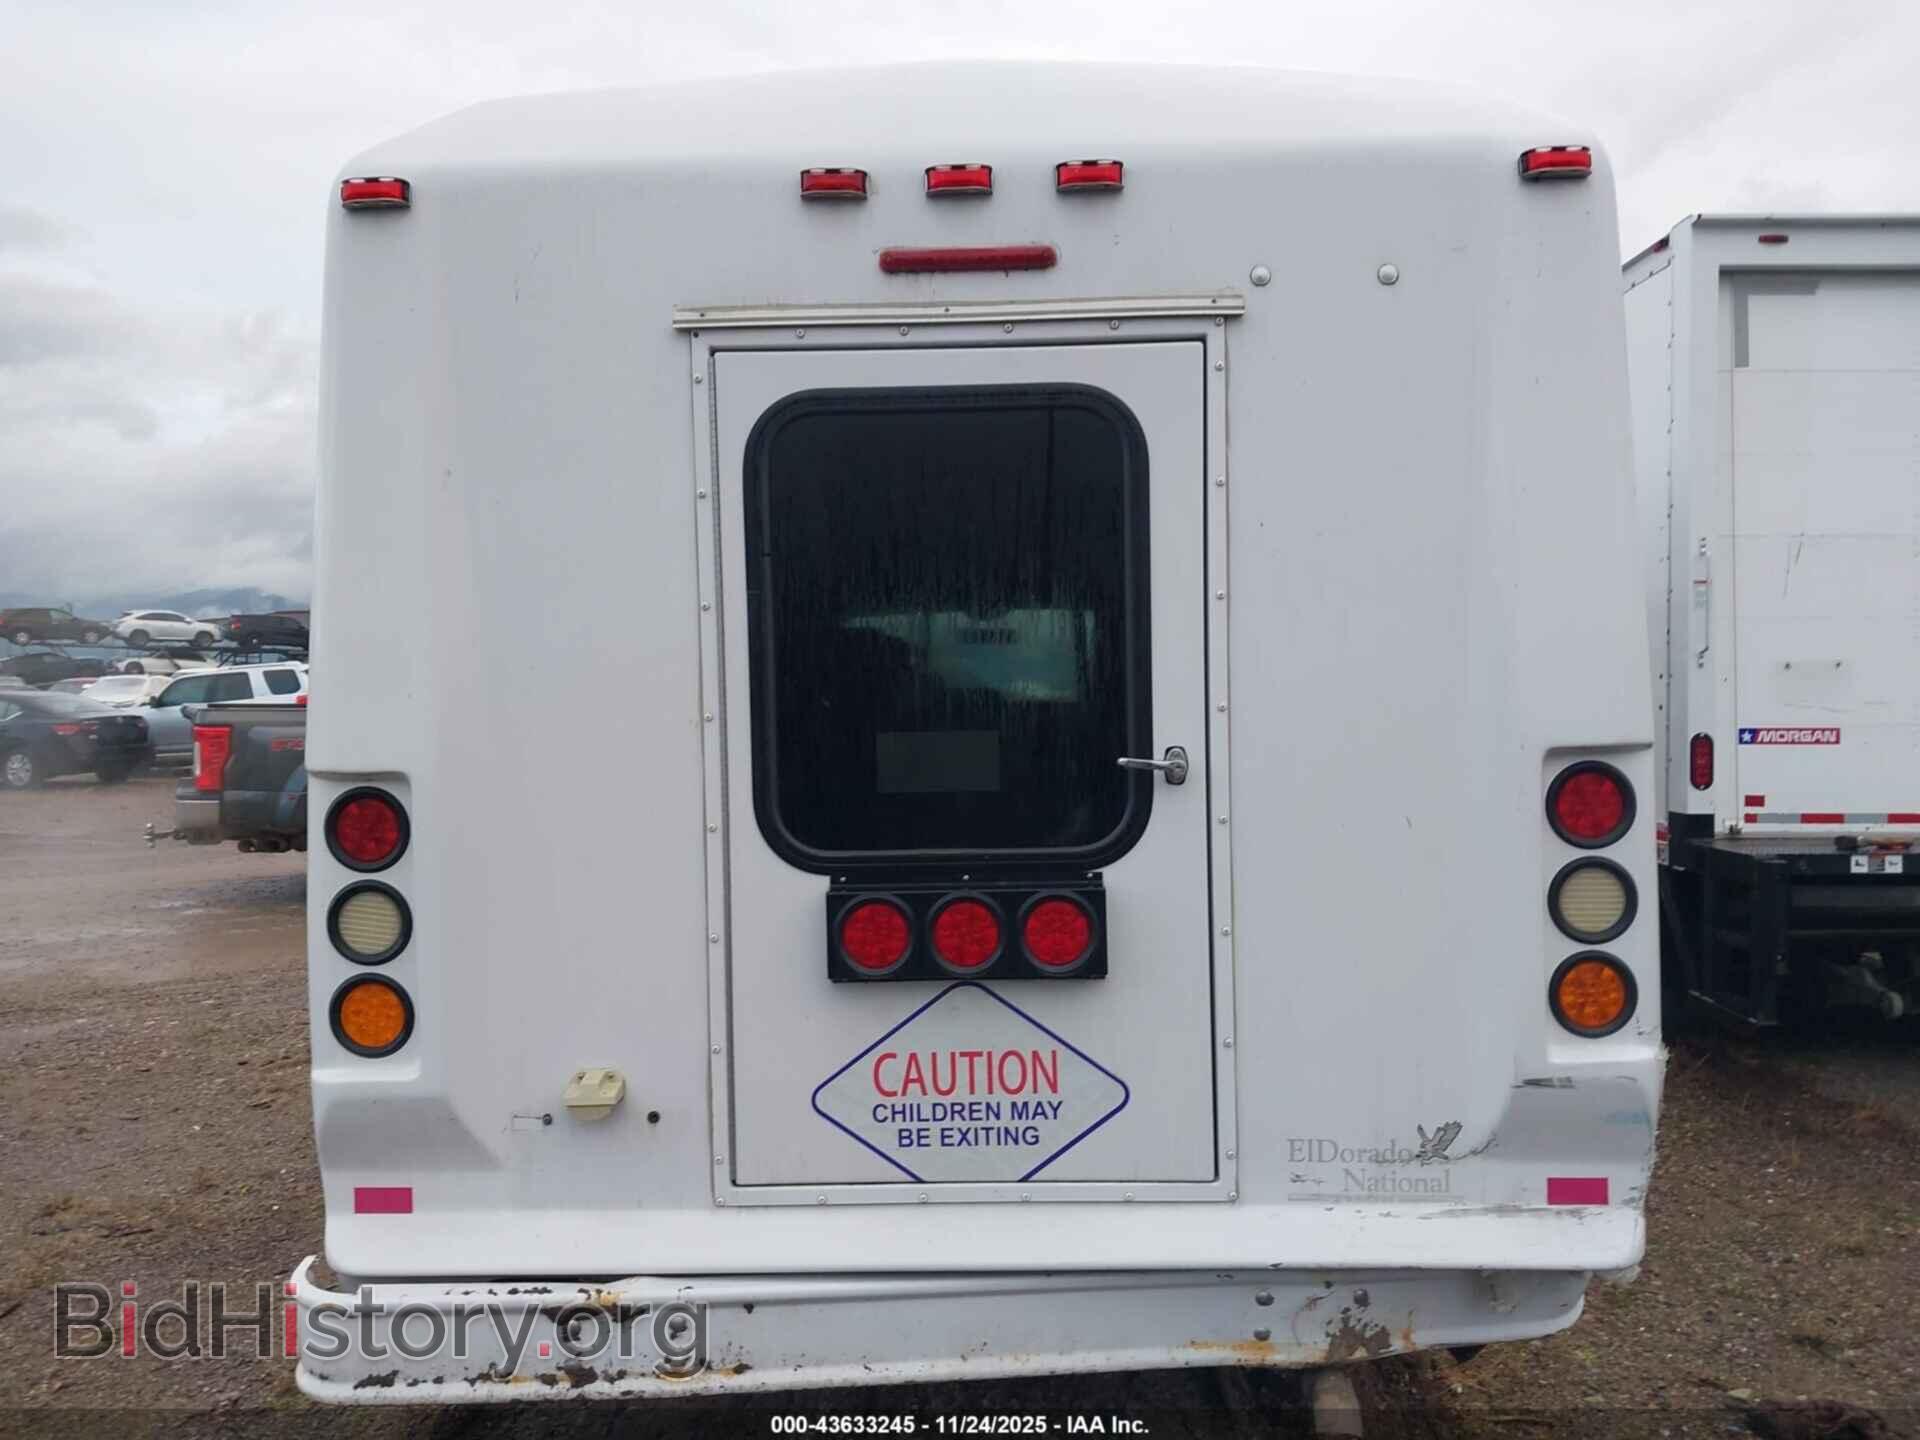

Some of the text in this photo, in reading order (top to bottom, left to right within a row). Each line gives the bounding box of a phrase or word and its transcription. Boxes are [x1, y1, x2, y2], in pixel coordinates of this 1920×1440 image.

[1757, 730, 1837, 743] MORGAN
[873, 1050, 1059, 1097] CAUTION
[872, 1100, 1063, 1123] CHILDREN MAY
[898, 1126, 1040, 1147] BE EXITING
[1287, 1138, 1416, 1164] ElDorado
[1342, 1168, 1450, 1193] National
